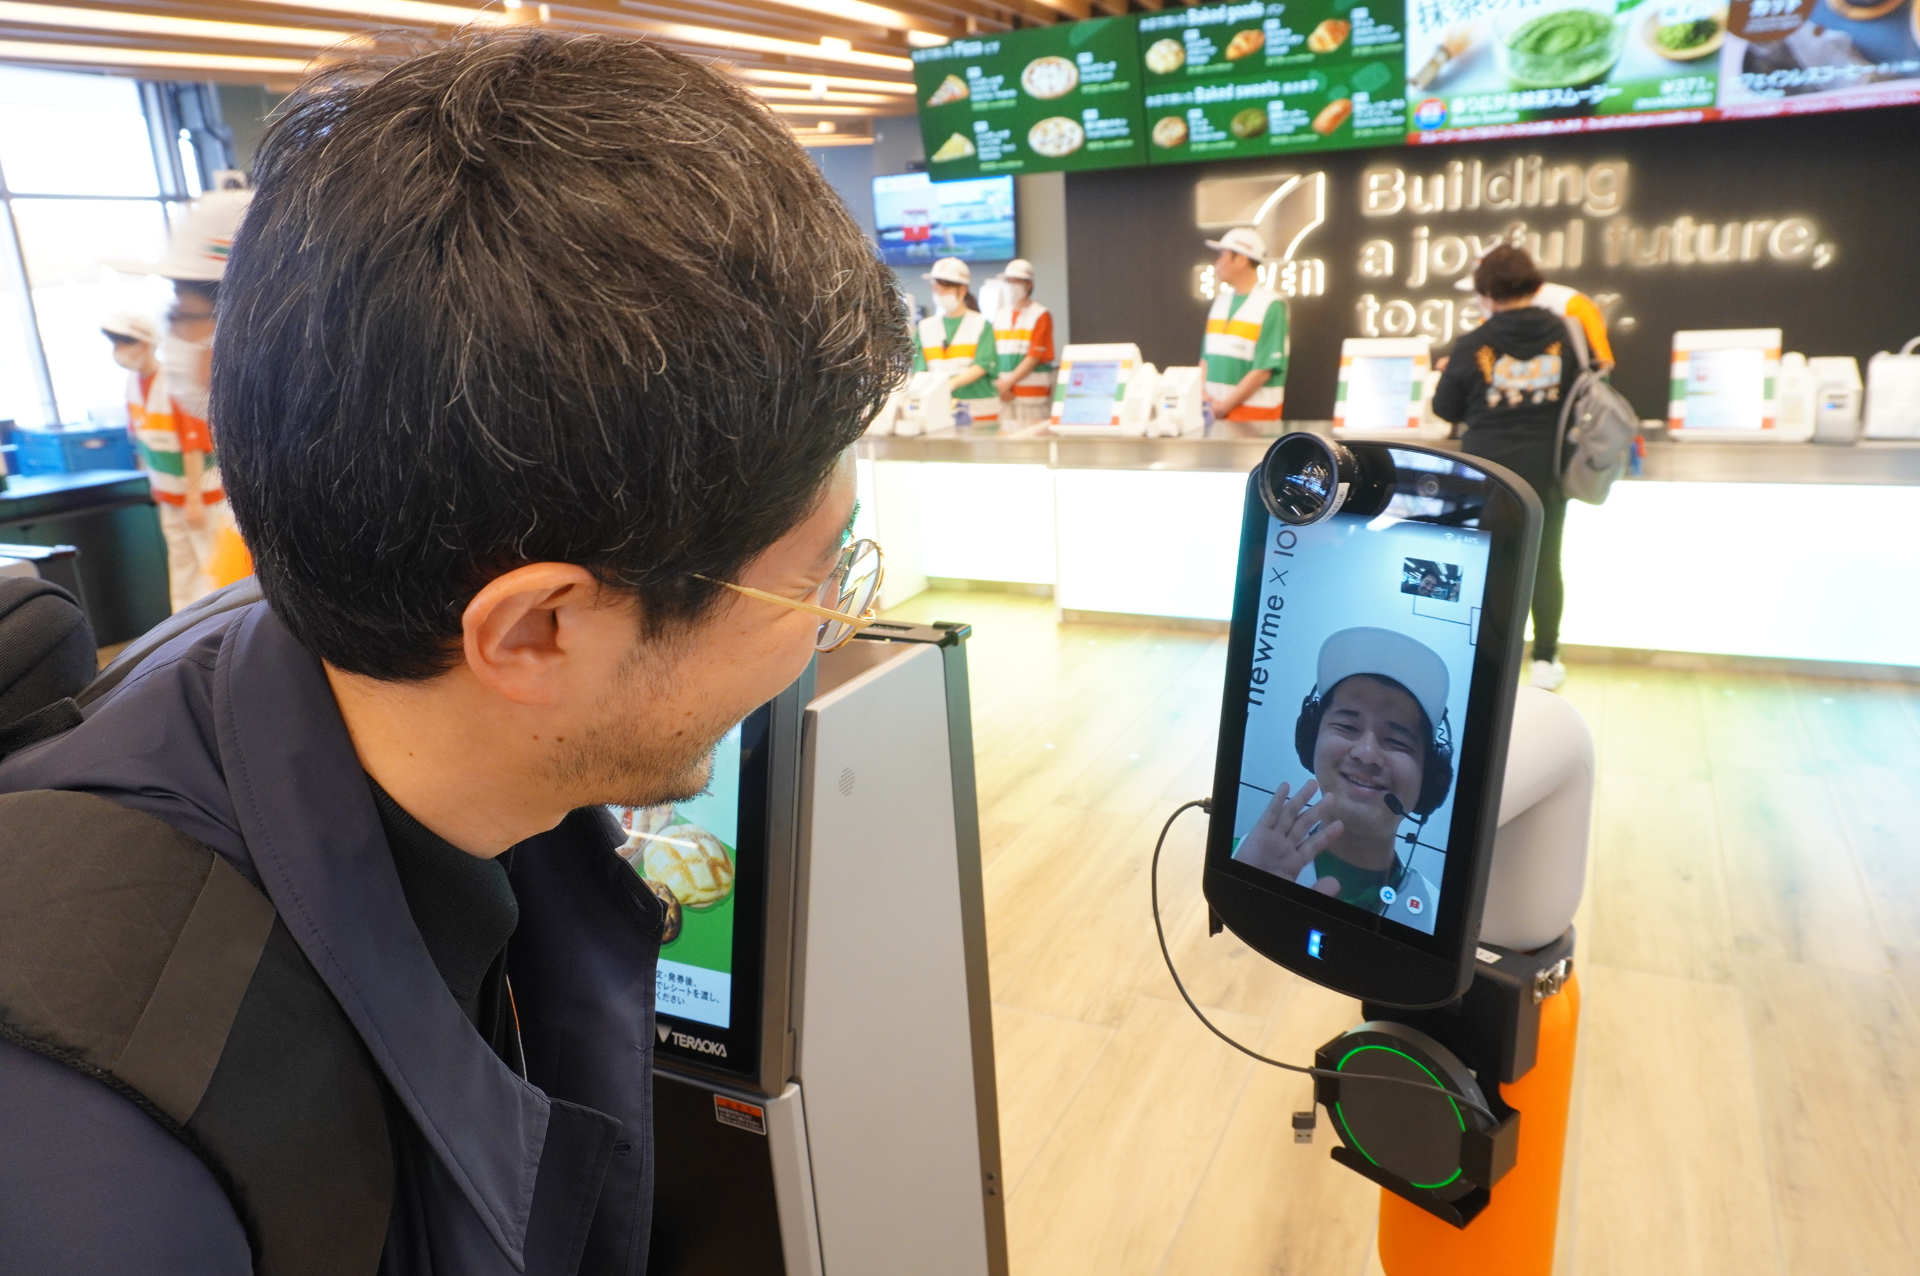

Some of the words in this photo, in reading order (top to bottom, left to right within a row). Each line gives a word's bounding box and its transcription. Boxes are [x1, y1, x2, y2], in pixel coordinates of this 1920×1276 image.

[1187, 4, 1227, 26] Baked
[1194, 82, 1235, 104] Baked
[1235, 80, 1281, 100] sweets
[1360, 155, 1628, 217] Building
[1357, 239, 1394, 278] a
[1604, 215, 1837, 269] future,
[1248, 594, 1285, 707] newme
[656, 991, 686, 1005] ください
[671, 1031, 728, 1058] TERAOKA
